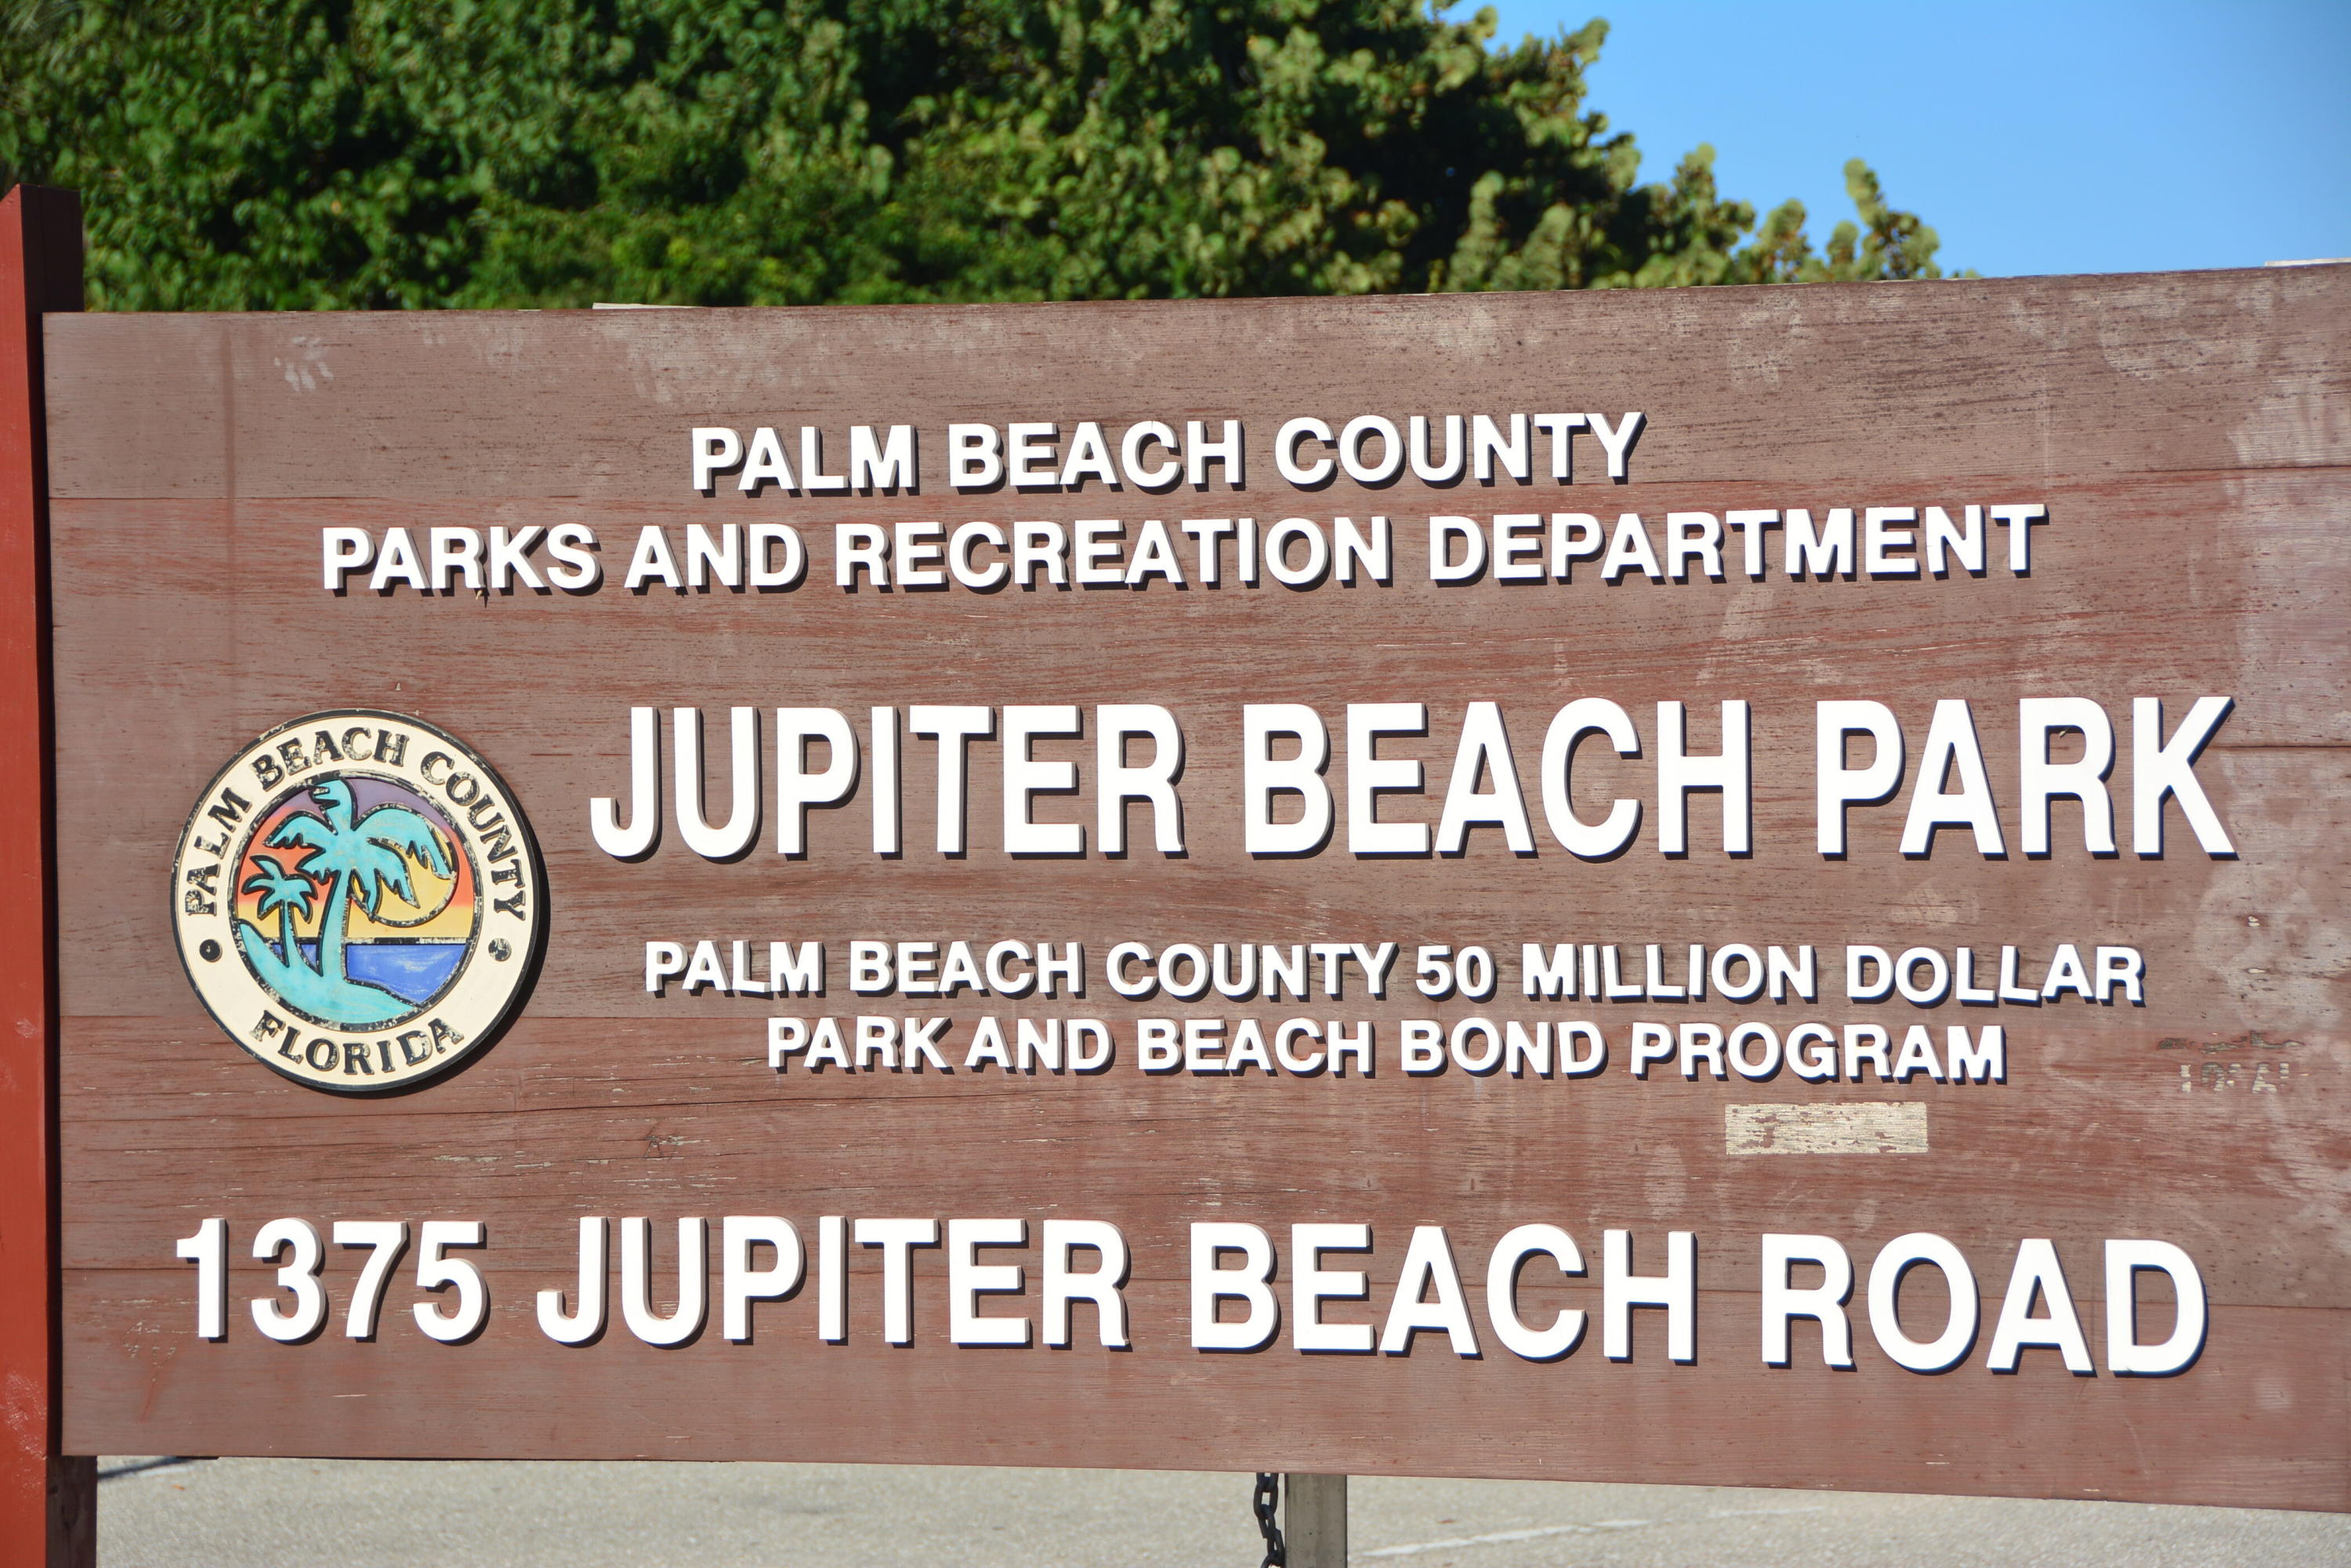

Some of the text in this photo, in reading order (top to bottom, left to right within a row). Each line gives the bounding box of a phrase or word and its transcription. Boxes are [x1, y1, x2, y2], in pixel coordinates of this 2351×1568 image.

[693, 412, 1643, 491] PALM BEACH COUNTY
[322, 503, 2046, 592] PARKS AND RECREATION DEPARTMENT
[589, 696, 2236, 857] JUPITER BEACH PARK
[184, 726, 527, 922] PALM BEACH COUNTY
[646, 939, 2143, 1005] PALM BEACH COUNTY 50 MILLION DOLLAR
[248, 1009, 465, 1075] FLORIDA
[768, 1016, 2005, 1081] PARK AND BEACH BOND PROGRAM
[176, 1215, 2206, 1374] 1375 JUPITER BEACH ROAD
